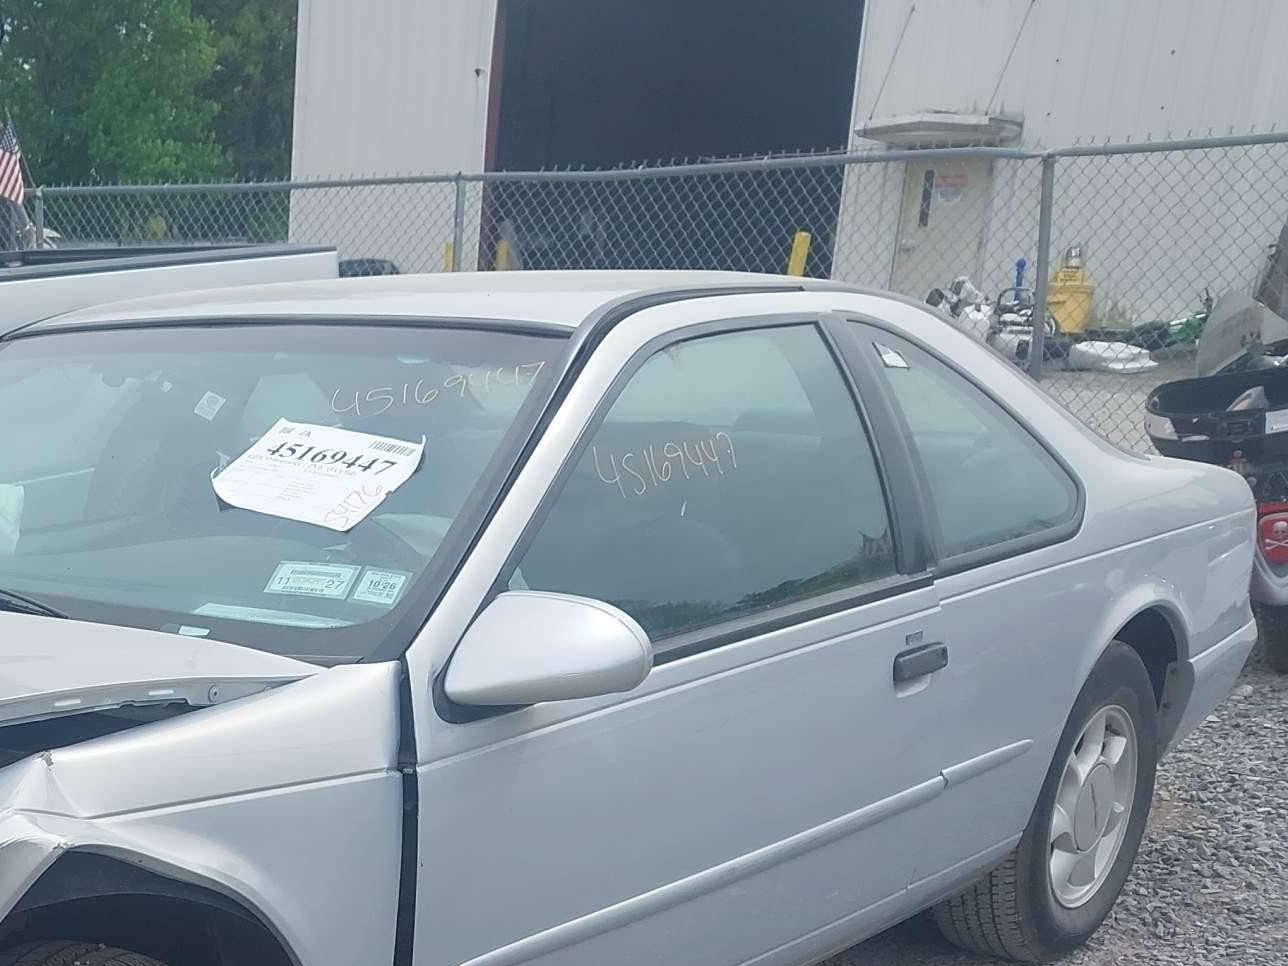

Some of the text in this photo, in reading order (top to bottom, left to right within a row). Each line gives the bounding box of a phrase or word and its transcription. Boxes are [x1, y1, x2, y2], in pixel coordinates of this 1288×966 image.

[266, 441, 397, 476] 45169447
[592, 431, 737, 499] 45169447
[325, 579, 345, 590] 27
